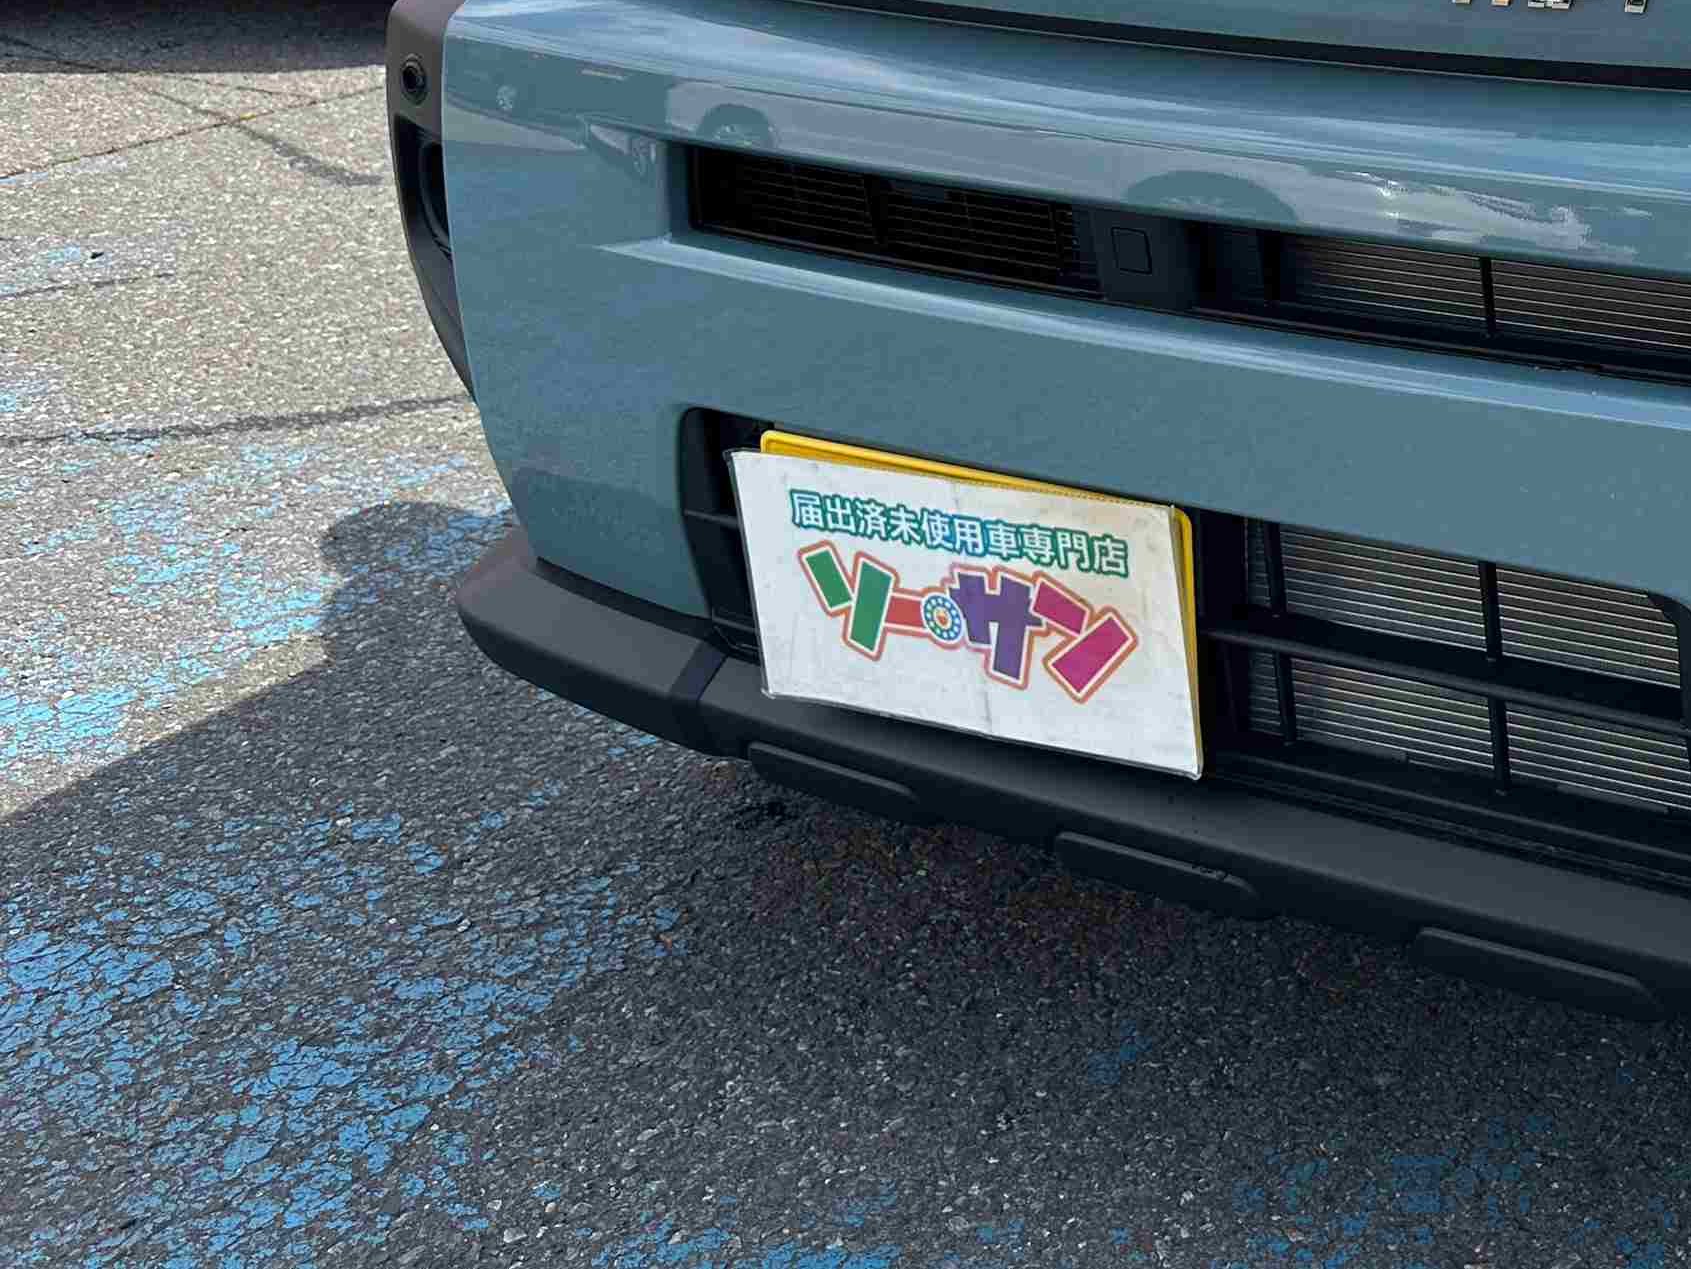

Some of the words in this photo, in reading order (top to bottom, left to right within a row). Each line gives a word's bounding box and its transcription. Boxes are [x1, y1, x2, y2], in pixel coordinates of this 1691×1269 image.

[789, 489, 1129, 578] 届出済未使用車専門店
